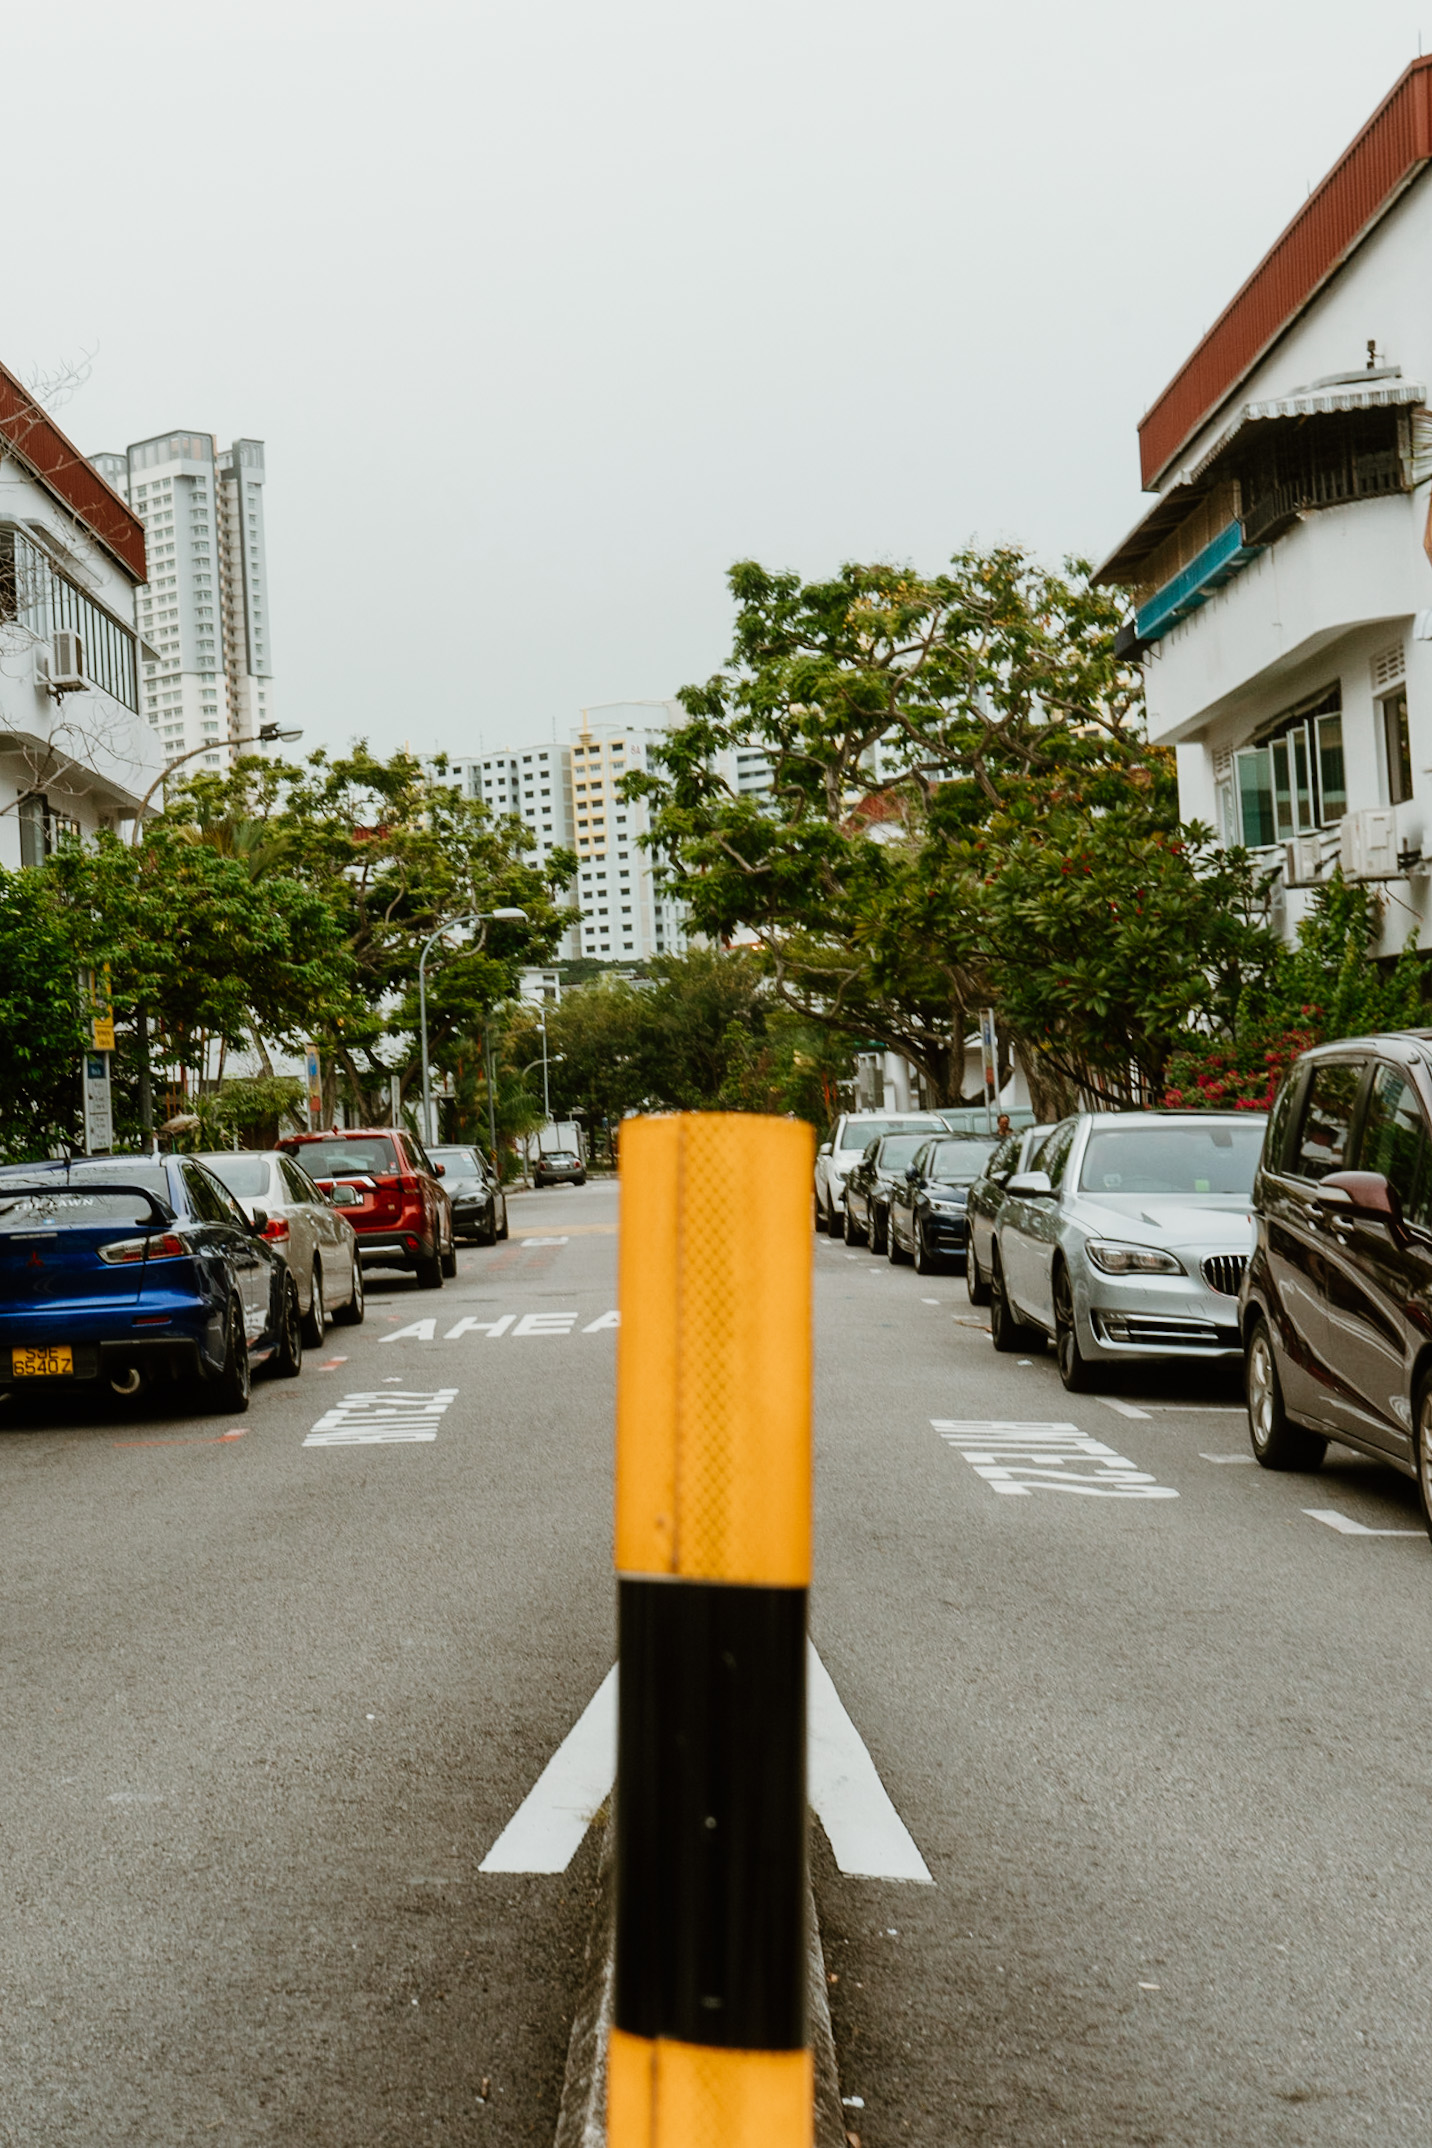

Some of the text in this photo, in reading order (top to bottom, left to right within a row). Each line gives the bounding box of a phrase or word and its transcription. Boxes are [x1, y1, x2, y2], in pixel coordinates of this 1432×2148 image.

[377, 1309, 622, 1343] AHEA
[25, 1346, 59, 1360] SJE
[13, 1358, 72, 1375] 6540Z
